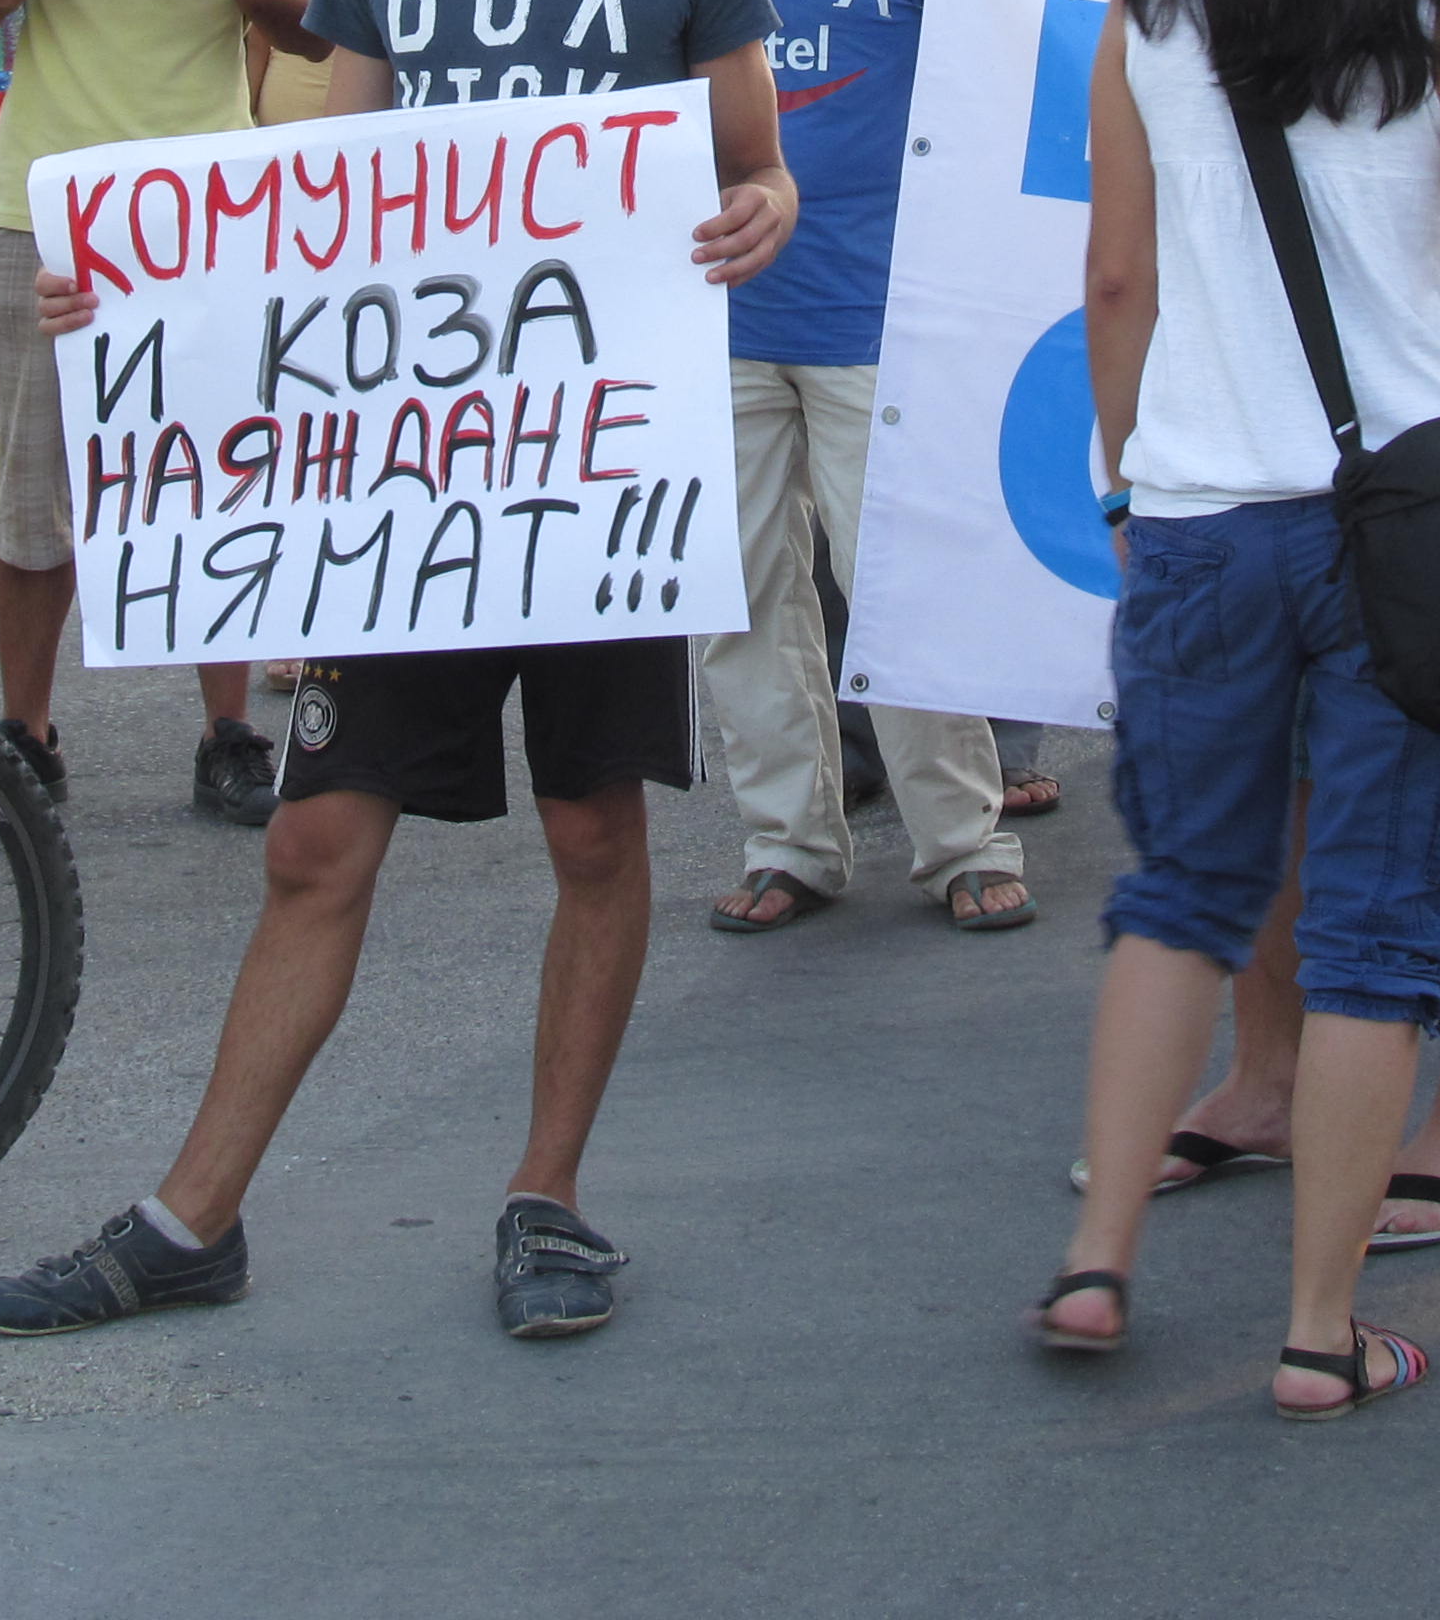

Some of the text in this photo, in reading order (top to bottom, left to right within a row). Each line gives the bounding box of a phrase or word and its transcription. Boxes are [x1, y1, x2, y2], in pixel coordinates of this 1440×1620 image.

[764, 24, 830, 72] tel
[66, 110, 680, 297] КОМУНИСТ
[93, 259, 599, 424] И КОЗА
